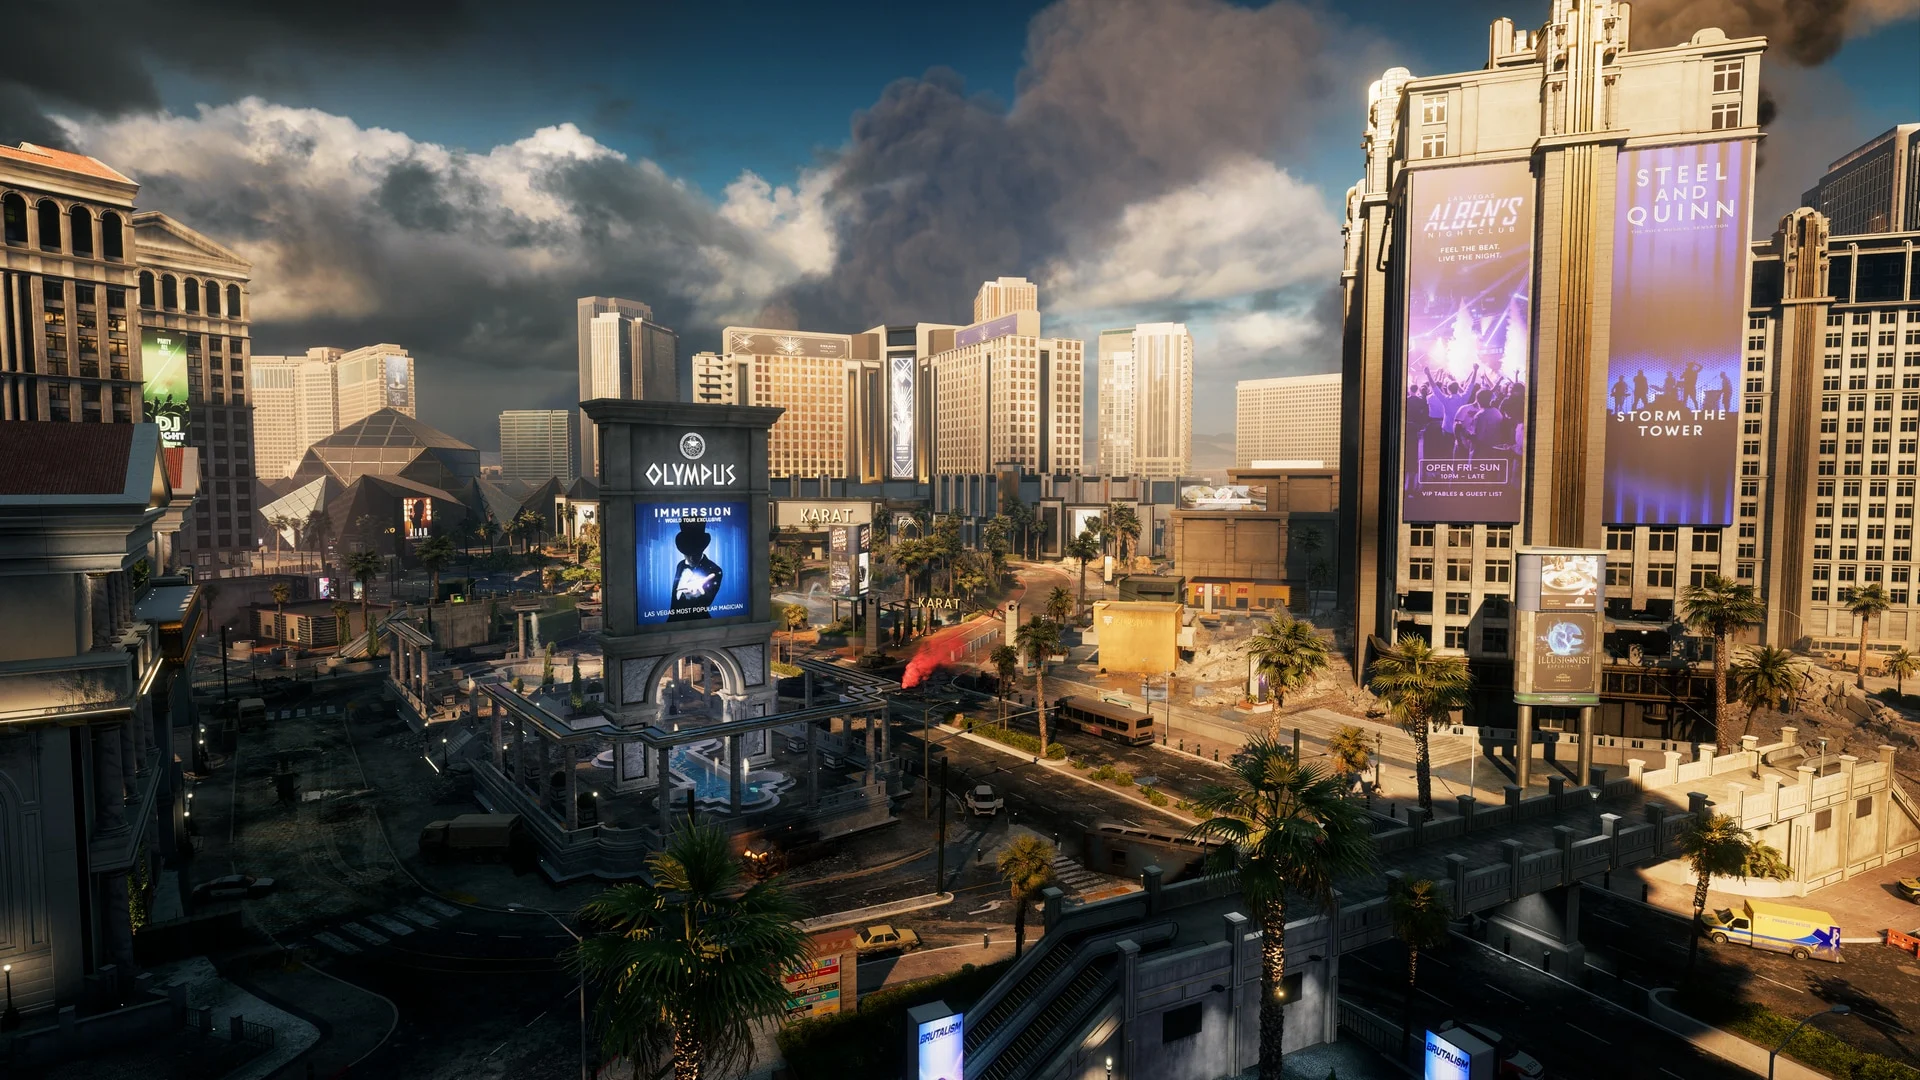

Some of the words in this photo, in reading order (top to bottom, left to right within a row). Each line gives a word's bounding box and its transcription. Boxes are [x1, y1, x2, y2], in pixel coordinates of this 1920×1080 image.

[1636, 162, 1727, 187] STEEL
[1467, 192, 1495, 200] VEGAS
[1655, 185, 1707, 202] AND
[1423, 196, 1524, 232] ALBEN'S
[1627, 199, 1735, 226] QUINN
[1427, 226, 1515, 239] NIGHTCLUB
[1440, 246, 1459, 254] FEEL
[1478, 243, 1500, 251] BEAT.
[1438, 255, 1456, 263] LIVE
[1458, 253, 1473, 261] THE
[1475, 251, 1502, 260] NIGHT.
[1617, 410, 1681, 422] STORM
[1691, 409, 1726, 421] THE
[155, 415, 181, 432] DJ
[160, 431, 186, 441] IGHT
[1638, 425, 1703, 437] TOWER
[1426, 463, 1454, 472] OPEN
[1457, 463, 1472, 472] FRI
[1480, 463, 1500, 472] SUN
[645, 462, 737, 487] OLYMPUS
[654, 507, 732, 518] IMMERSION
[800, 508, 853, 523] KARAT
[918, 596, 961, 609] KARAT
[644, 610, 656, 618] LAS
[656, 608, 676, 616] VEGAS
[692, 605, 718, 613] POPULAR
[718, 602, 744, 611] MAGICIAN
[1538, 655, 1591, 665] ILLUSIONIST
[919, 1020, 962, 1045] BRUTALISM
[1426, 1041, 1469, 1069] BRUTALISM
